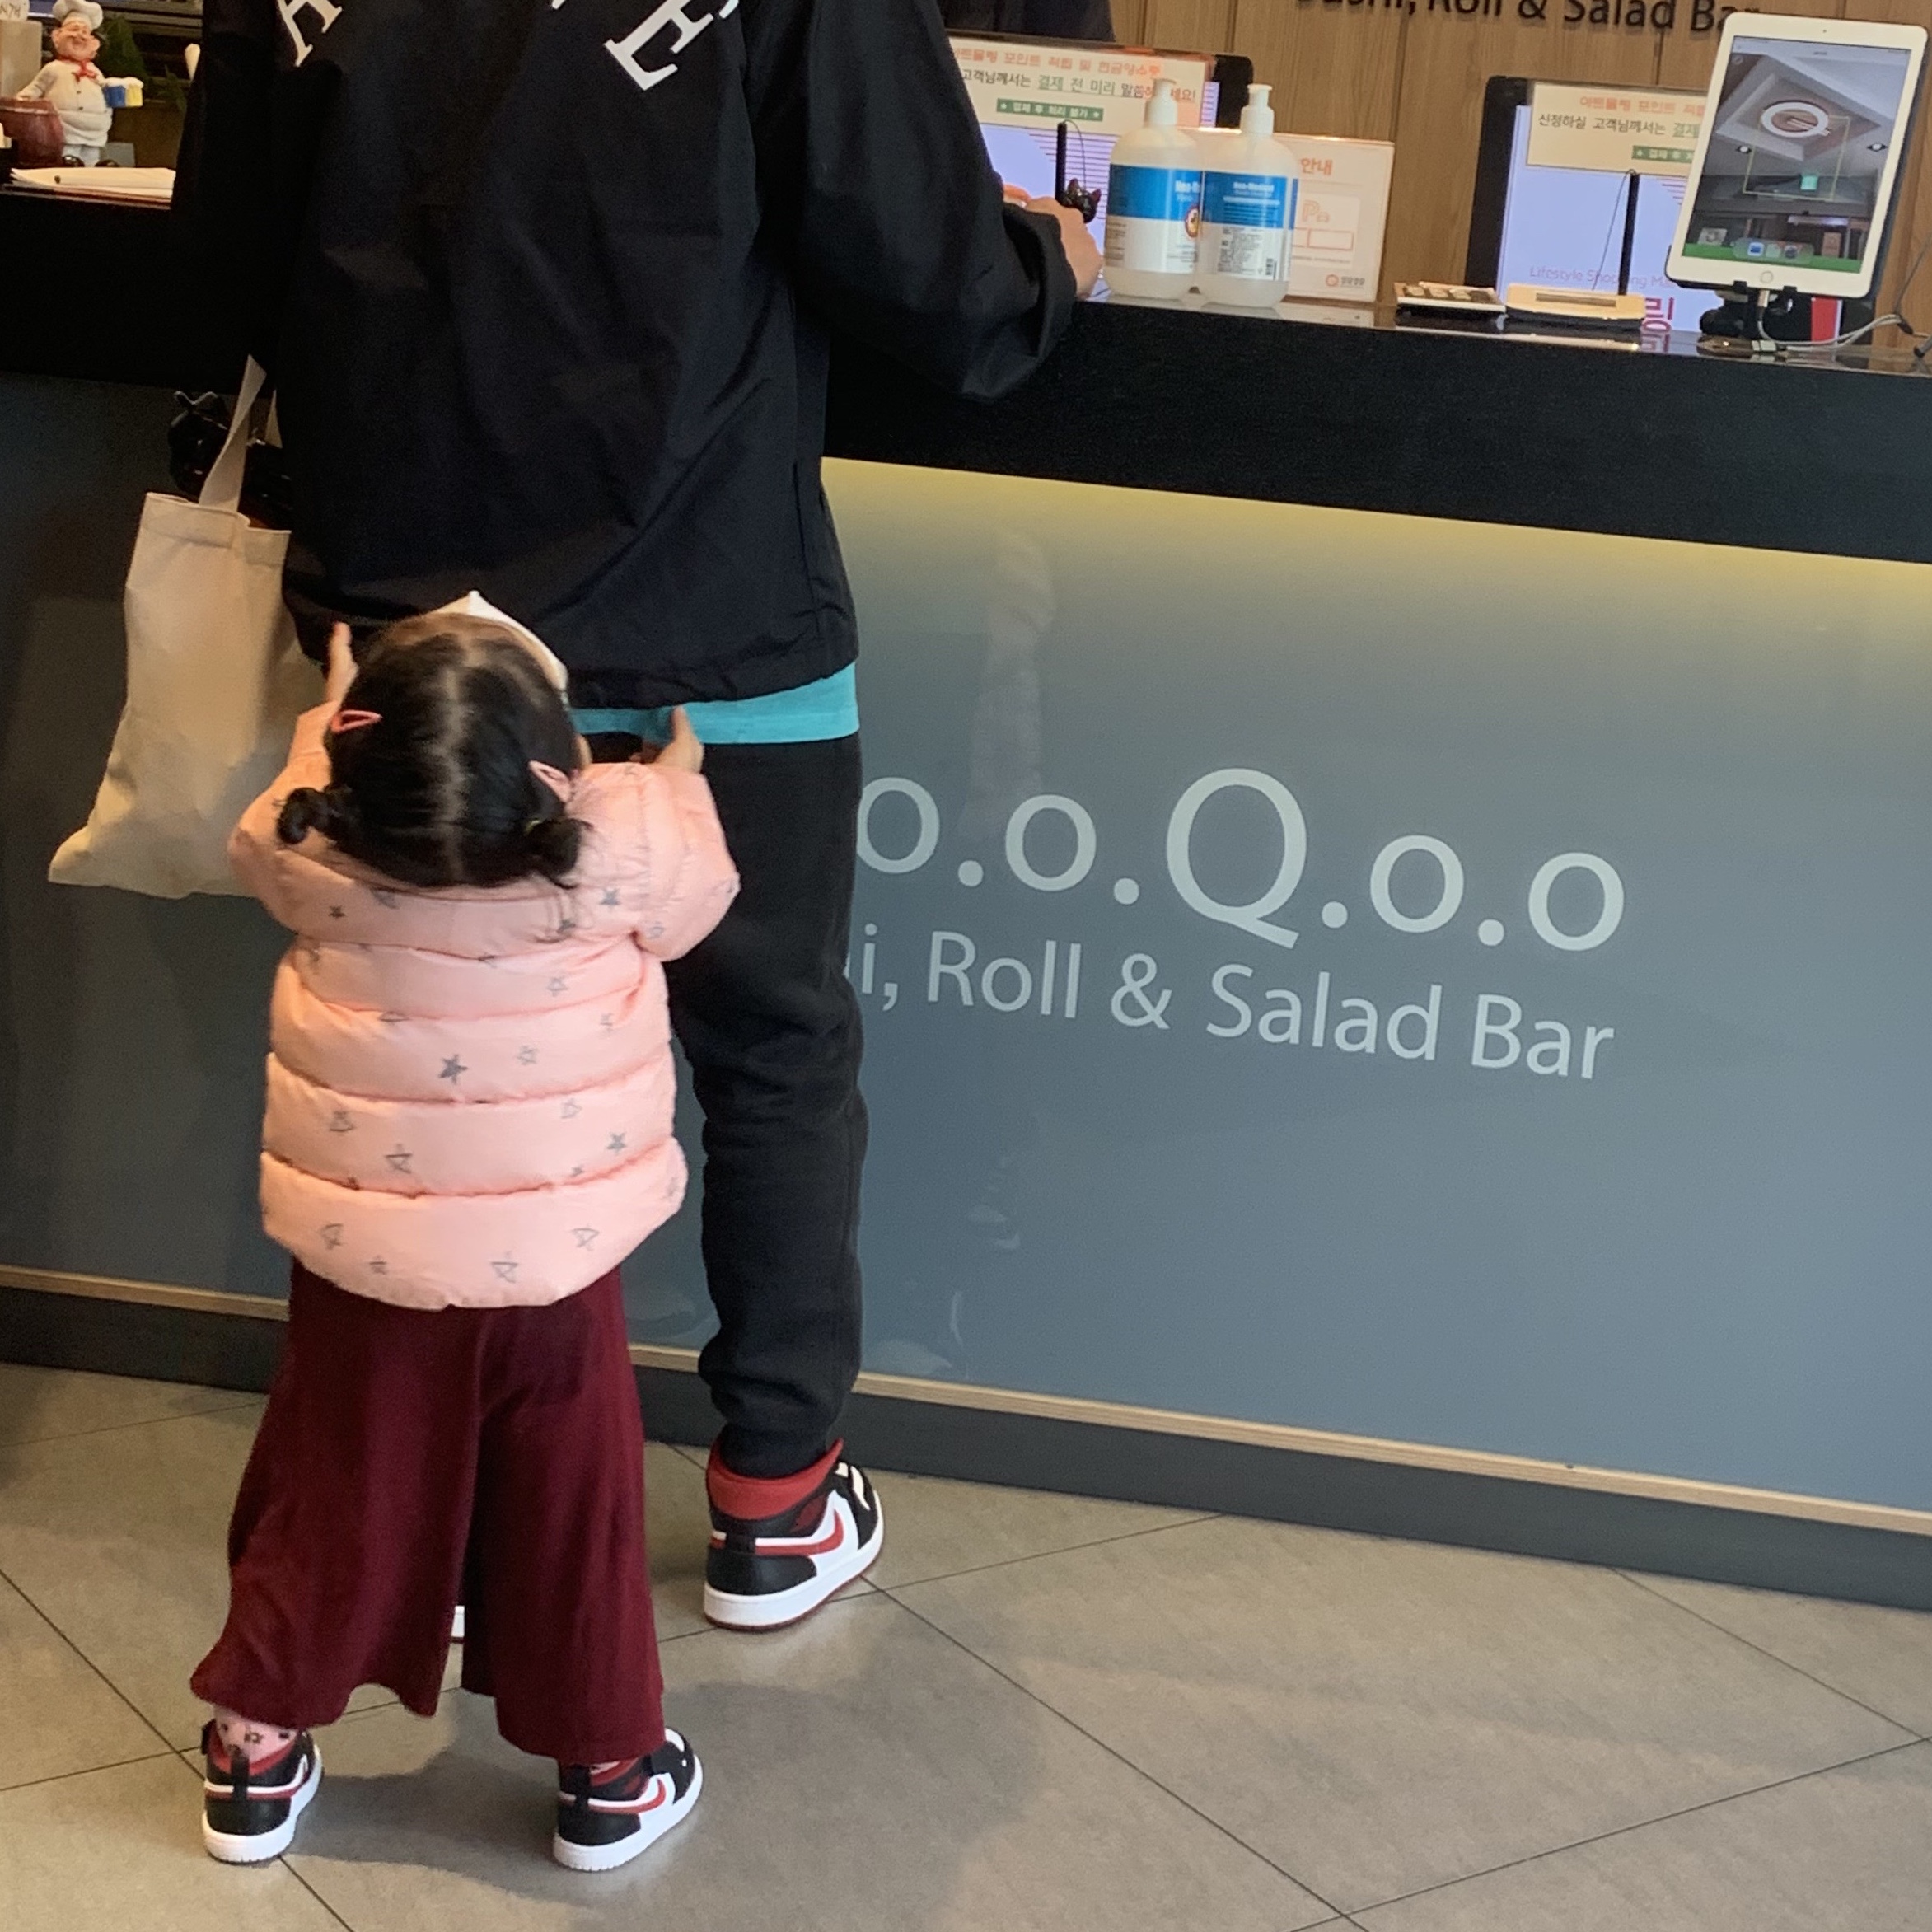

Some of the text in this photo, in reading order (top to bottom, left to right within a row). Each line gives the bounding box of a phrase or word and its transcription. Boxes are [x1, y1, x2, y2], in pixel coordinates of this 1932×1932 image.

[1090, 79, 1116, 96] 미리
[1301, 157, 1332, 175] 안내
[1529, 266, 1583, 283] Lifestyle
[928, 930, 1081, 1018] Roll
[1111, 952, 1172, 1030] &
[1205, 963, 1443, 1061] Salad
[1471, 993, 1615, 1079] Bar
